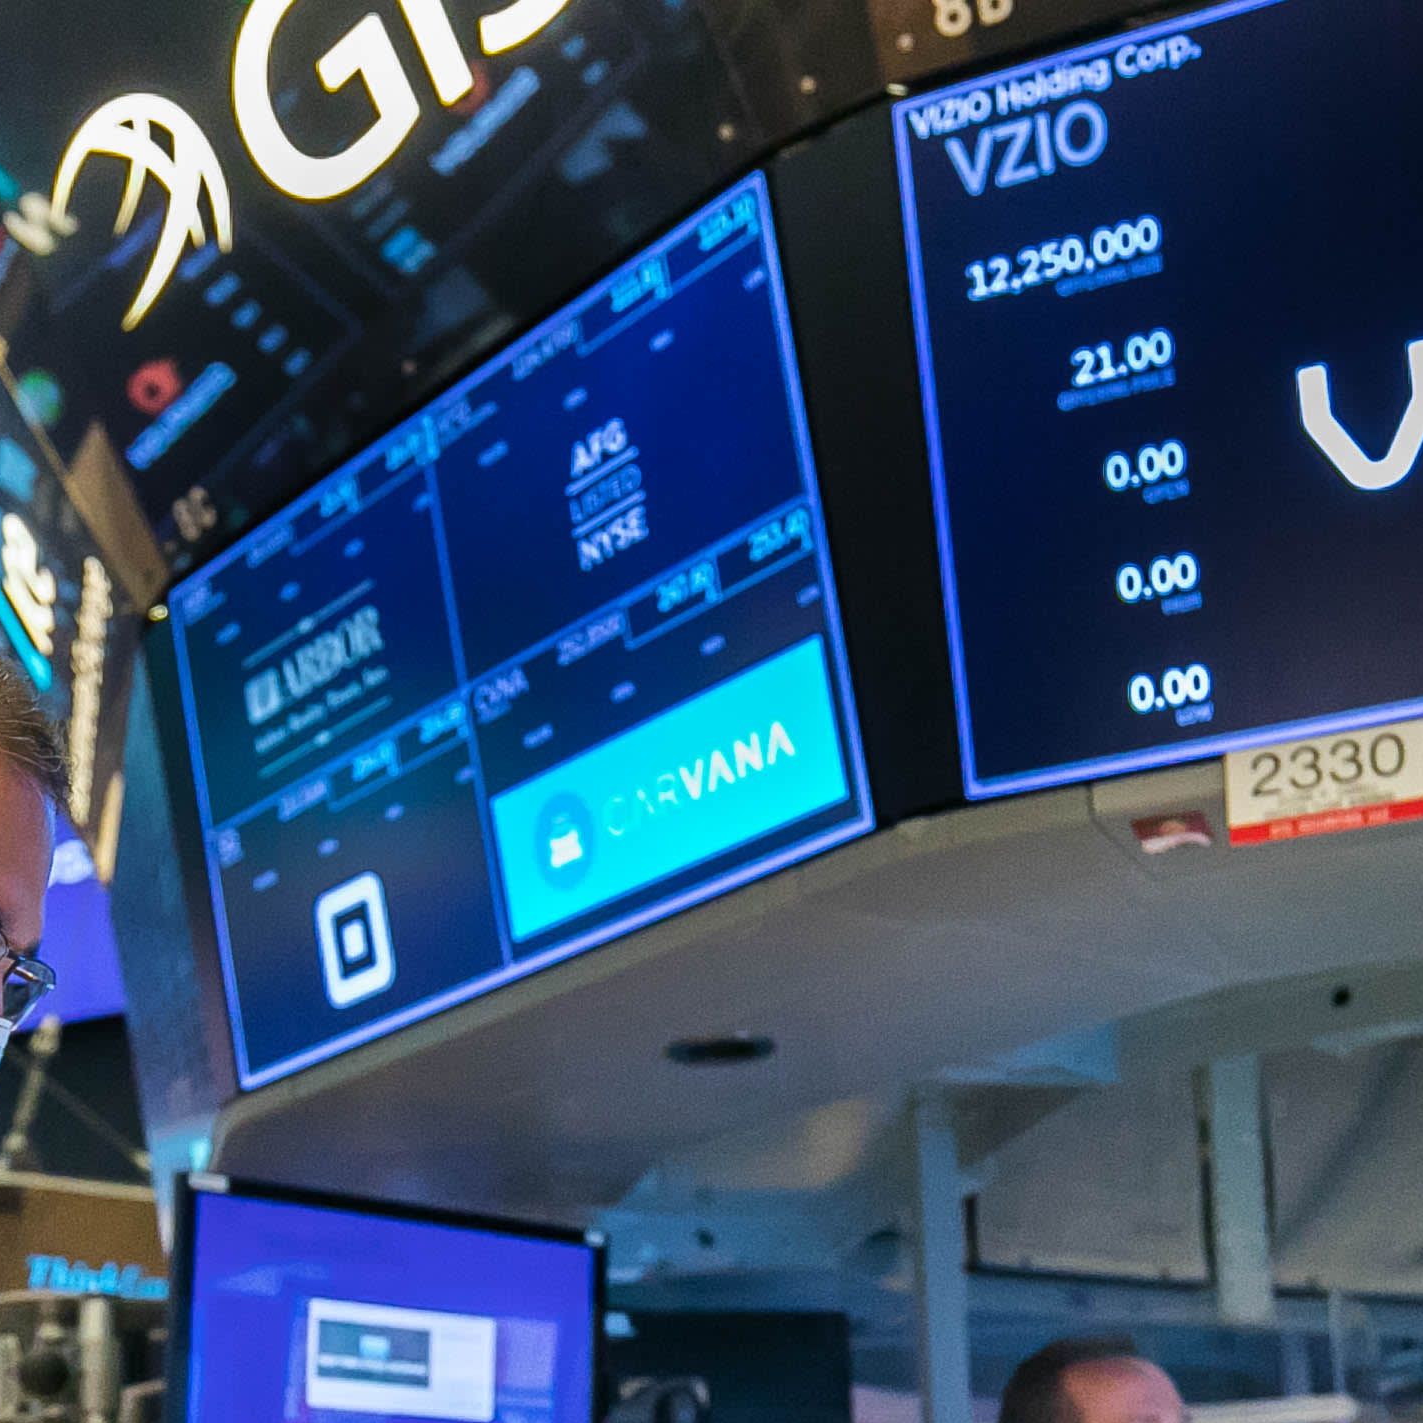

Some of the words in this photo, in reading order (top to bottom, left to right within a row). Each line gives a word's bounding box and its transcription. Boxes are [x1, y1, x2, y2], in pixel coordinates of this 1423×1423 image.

[908, 91, 992, 139] VIZIO
[994, 58, 1112, 116] Holding
[1115, 34, 1202, 78] Corp.
[944, 99, 1108, 196] VZIO
[965, 214, 1162, 301] 12,250,000
[1070, 327, 1175, 387] 21.00
[1104, 438, 1187, 491] 0.00
[577, 504, 649, 571] NYSE
[1116, 551, 1200, 603] 0.00
[1128, 663, 1211, 714] 0.00
[601, 720, 797, 837] CARVANA
[1249, 732, 1406, 798] 2330
